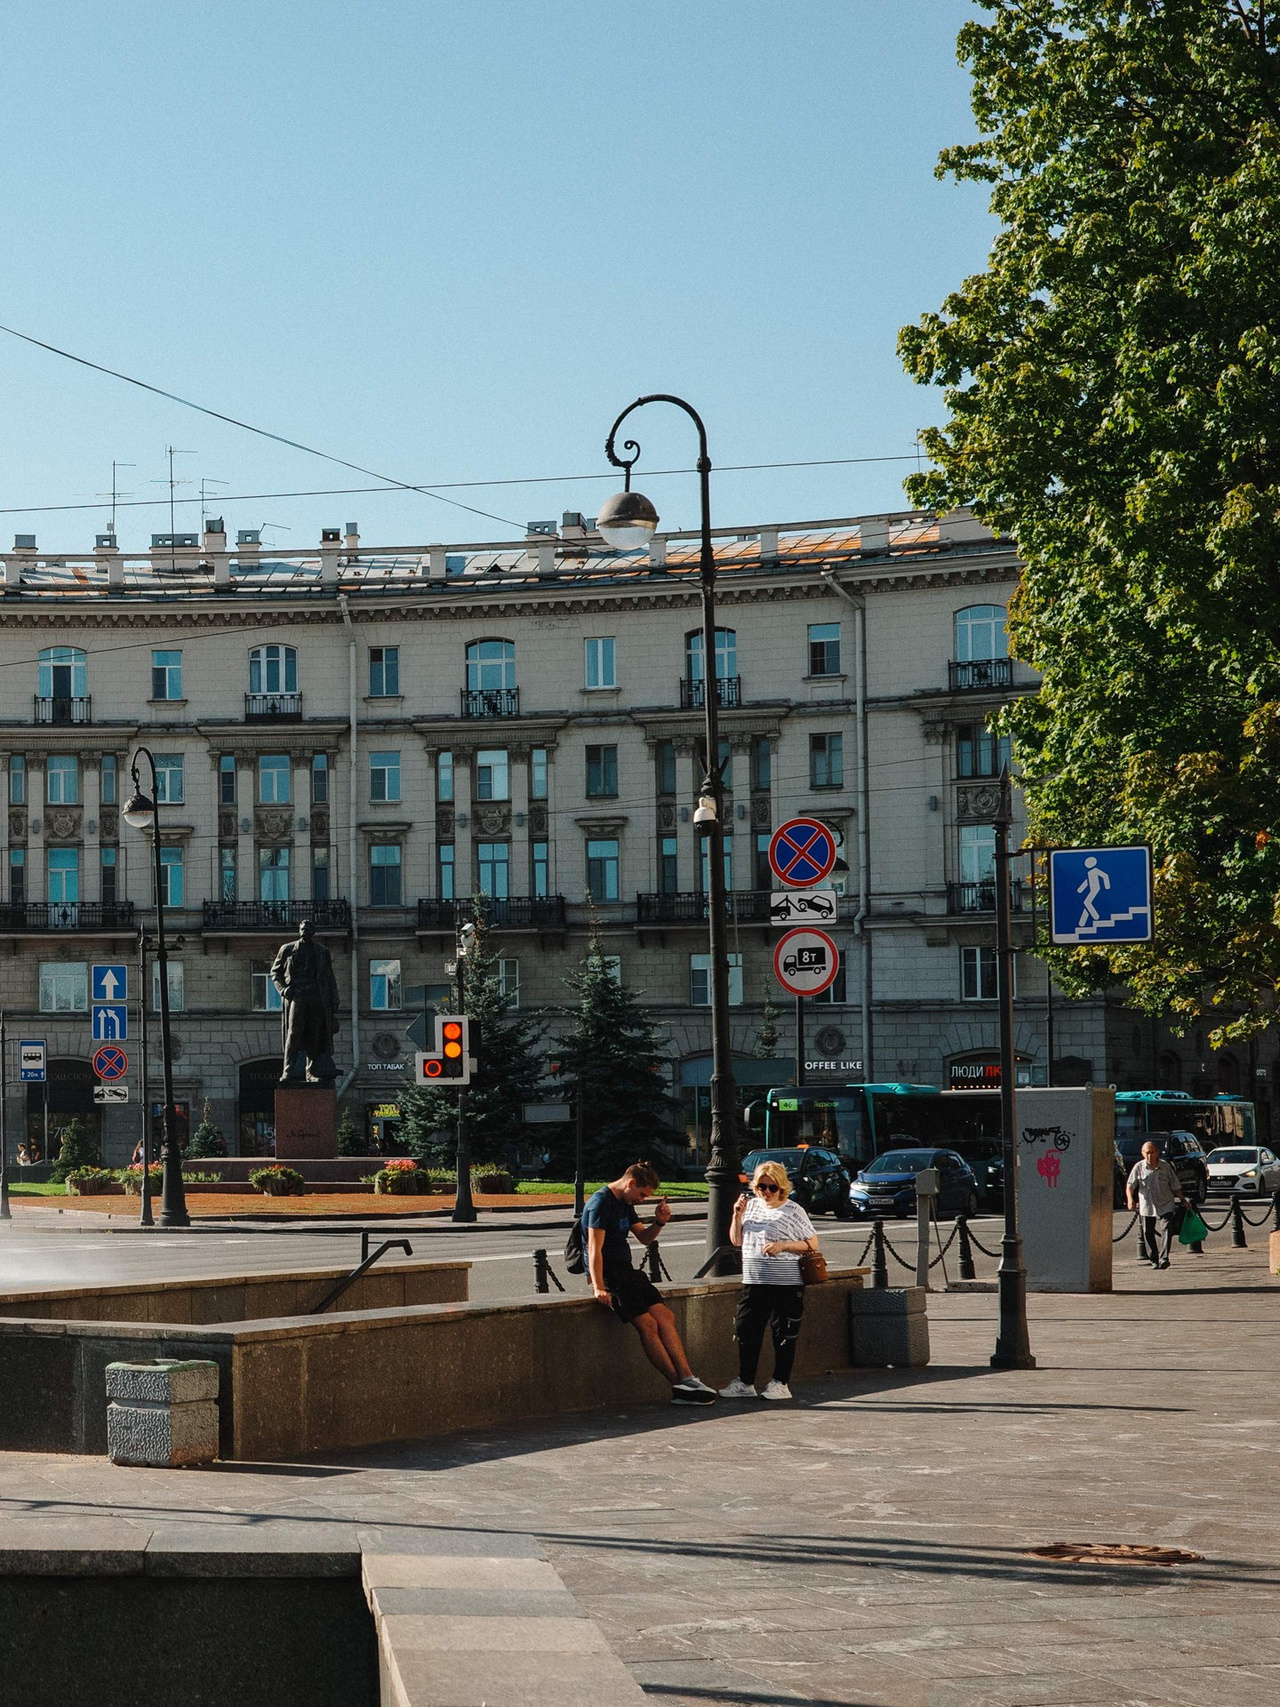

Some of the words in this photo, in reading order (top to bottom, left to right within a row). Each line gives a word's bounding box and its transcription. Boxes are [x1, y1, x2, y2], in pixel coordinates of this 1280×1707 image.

[804, 1061, 837, 1070] OFFEE
[840, 1061, 863, 1070] LIKE
[951, 1066, 984, 1079] ЛЮДИ
